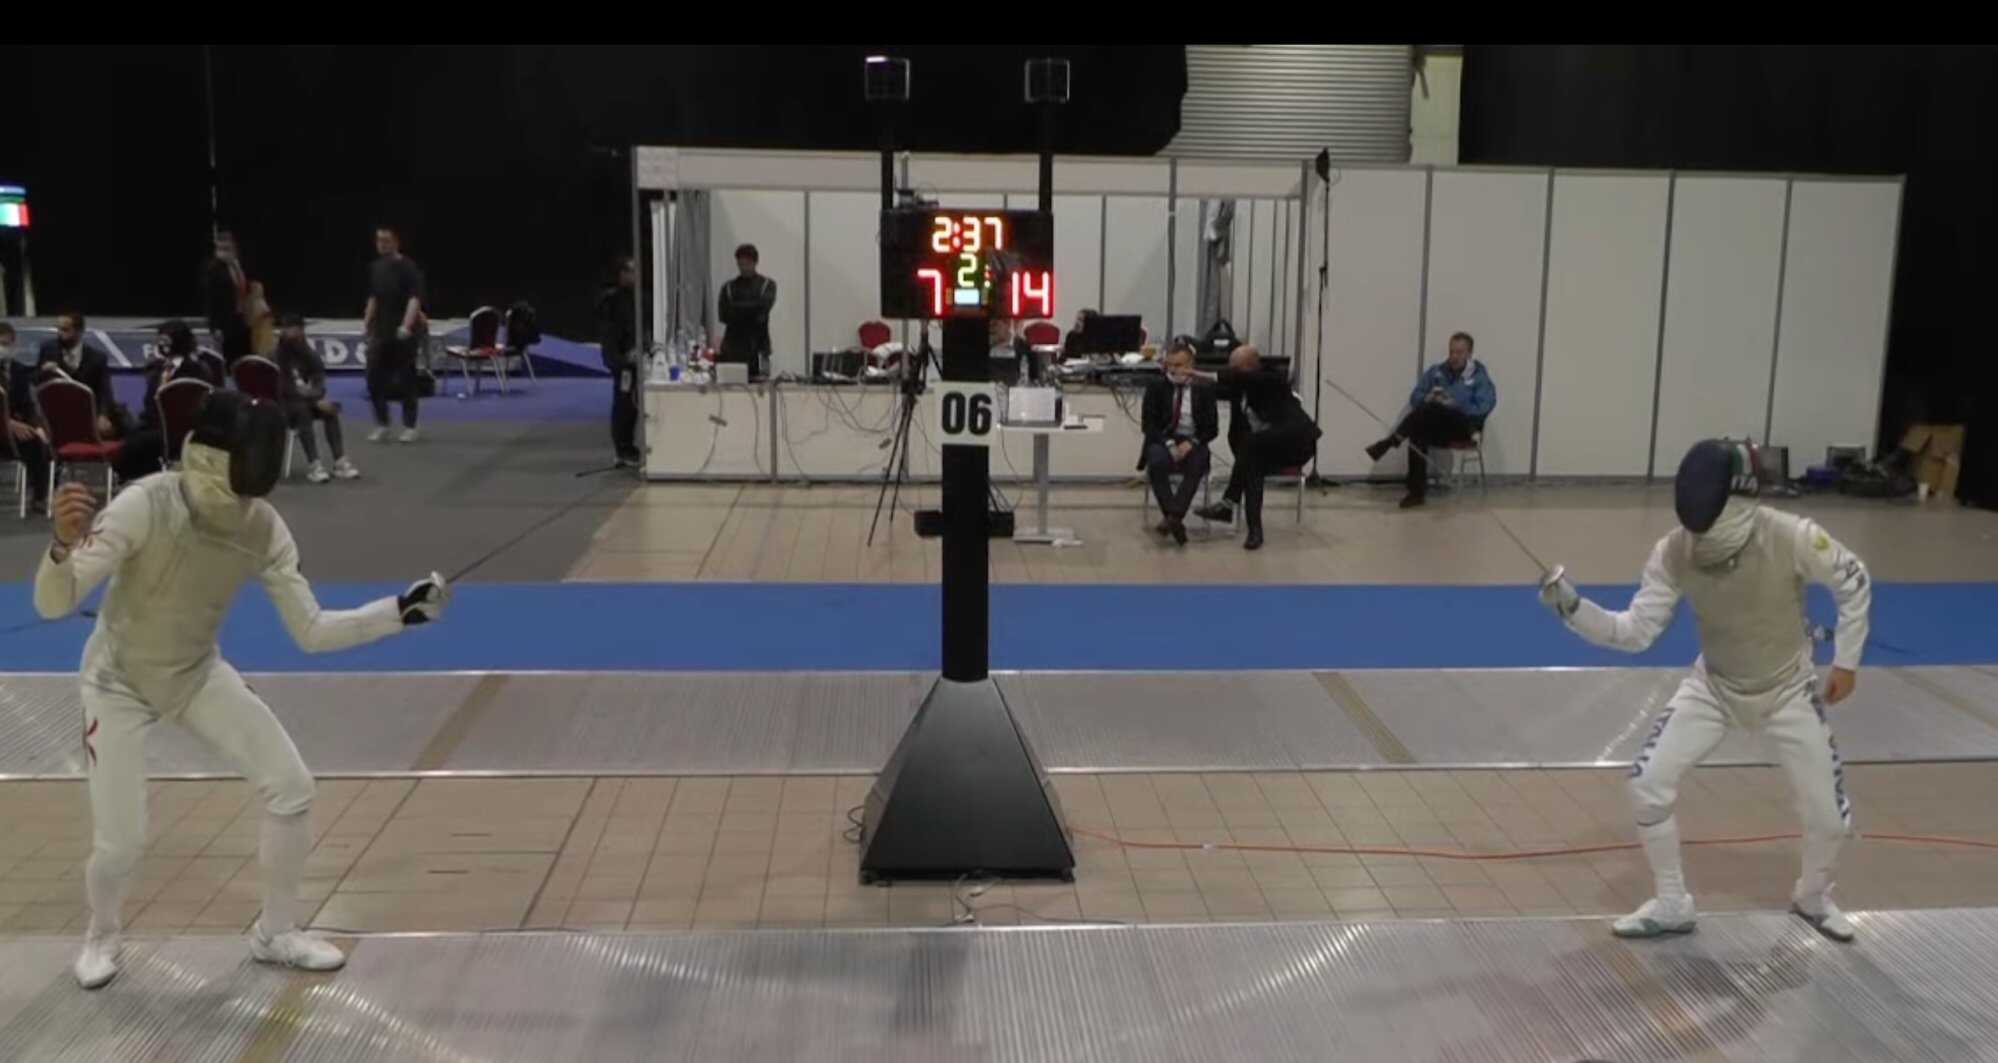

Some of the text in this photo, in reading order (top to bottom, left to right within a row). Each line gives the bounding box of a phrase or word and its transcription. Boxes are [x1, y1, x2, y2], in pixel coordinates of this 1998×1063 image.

[932, 216, 1003, 252] 2:37
[917, 268, 943, 315] 7
[957, 252, 978, 288] 2
[1012, 271, 1050, 315] 14
[942, 391, 992, 436] 06
